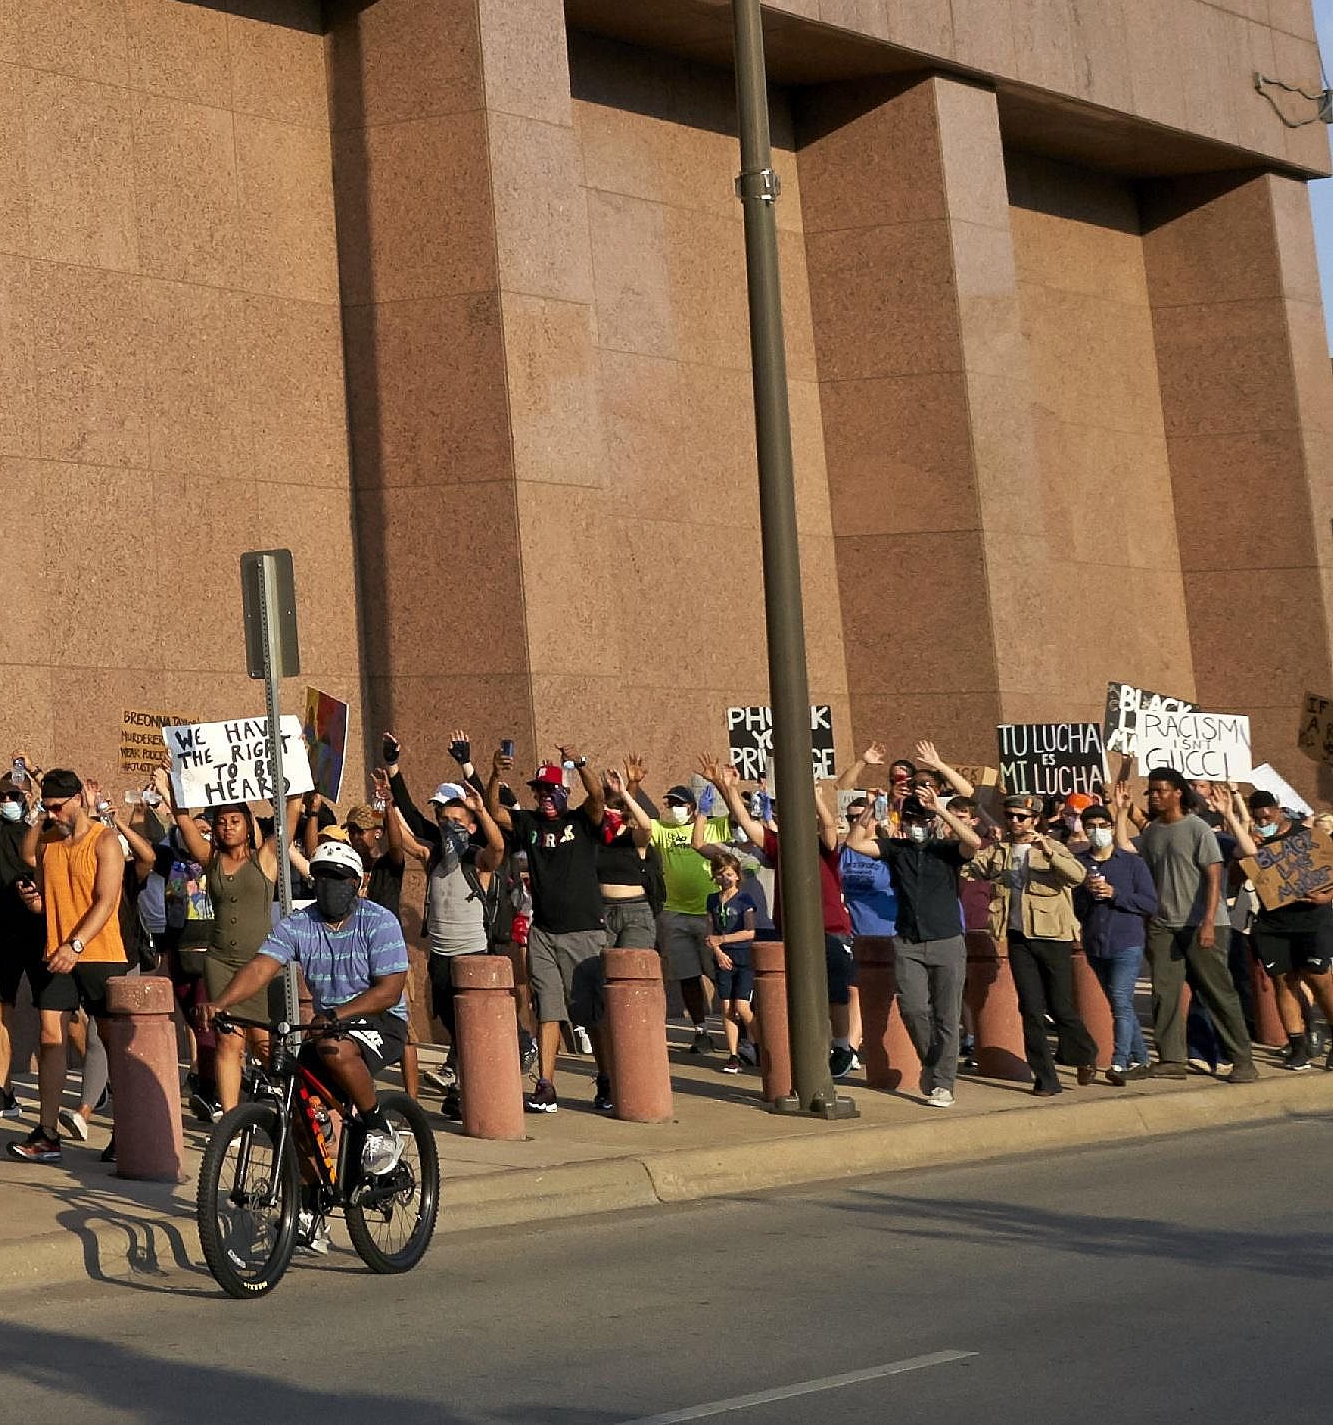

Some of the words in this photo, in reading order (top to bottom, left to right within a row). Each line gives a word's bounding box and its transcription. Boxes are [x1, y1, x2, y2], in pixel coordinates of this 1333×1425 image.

[727, 706, 831, 731] PHK
[1145, 713, 1239, 743] RACISM
[175, 726, 206, 751] WE
[224, 720, 282, 743] HAV
[996, 724, 1027, 756] TU
[1033, 723, 1102, 754] LUCHA
[178, 748, 213, 769] THE
[213, 762, 238, 781] TO
[1042, 753, 1056, 766] ES
[1146, 747, 1229, 778] GUCCI
[999, 760, 1031, 795] MI
[1033, 762, 1104, 795] LUCHA
